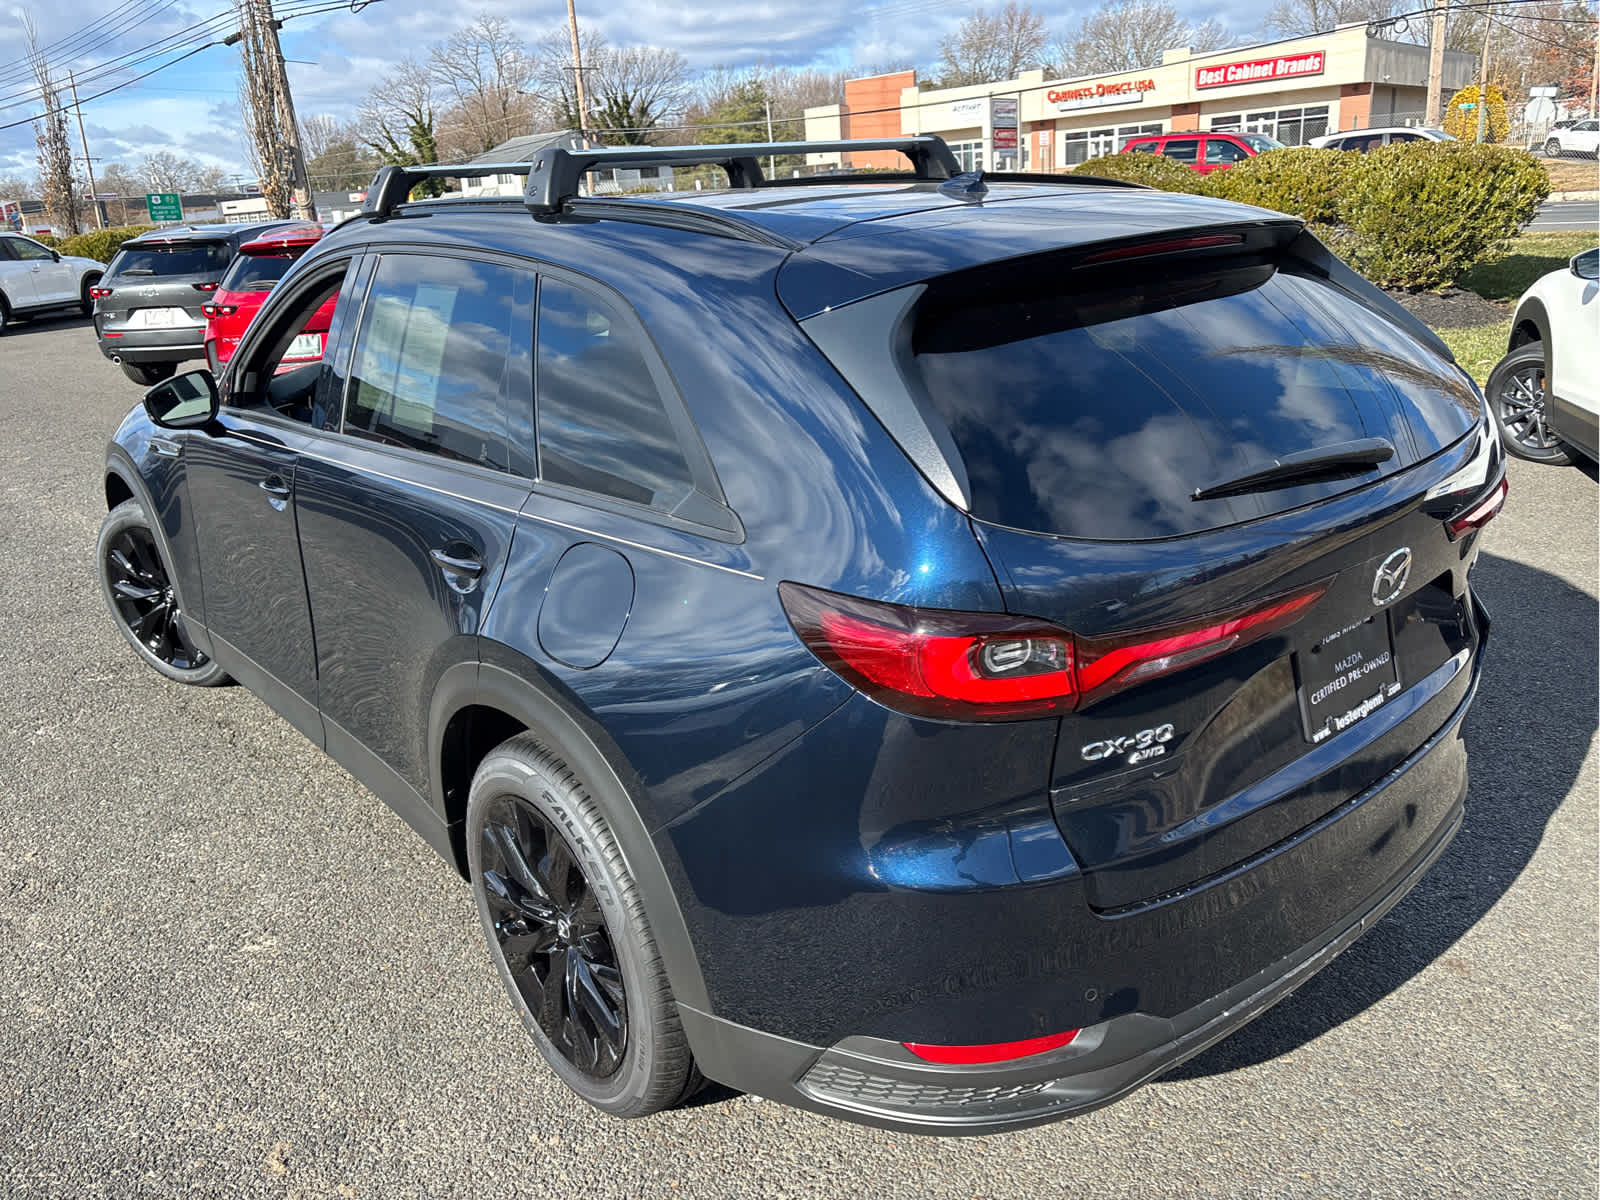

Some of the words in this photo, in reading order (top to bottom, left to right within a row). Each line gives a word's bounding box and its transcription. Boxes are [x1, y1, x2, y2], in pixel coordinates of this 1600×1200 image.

[1199, 68, 1225, 85] Best
[1227, 61, 1274, 81] Cabinet
[1276, 56, 1320, 75] Brands
[1311, 676, 1347, 704] CERTIFIED
[1348, 651, 1390, 683] PRE-OWNED
[1335, 651, 1363, 673] MAZDA
[1081, 723, 1175, 760] CX-90
[1128, 745, 1165, 764] AWD
[541, 790, 616, 908] FALKEN
